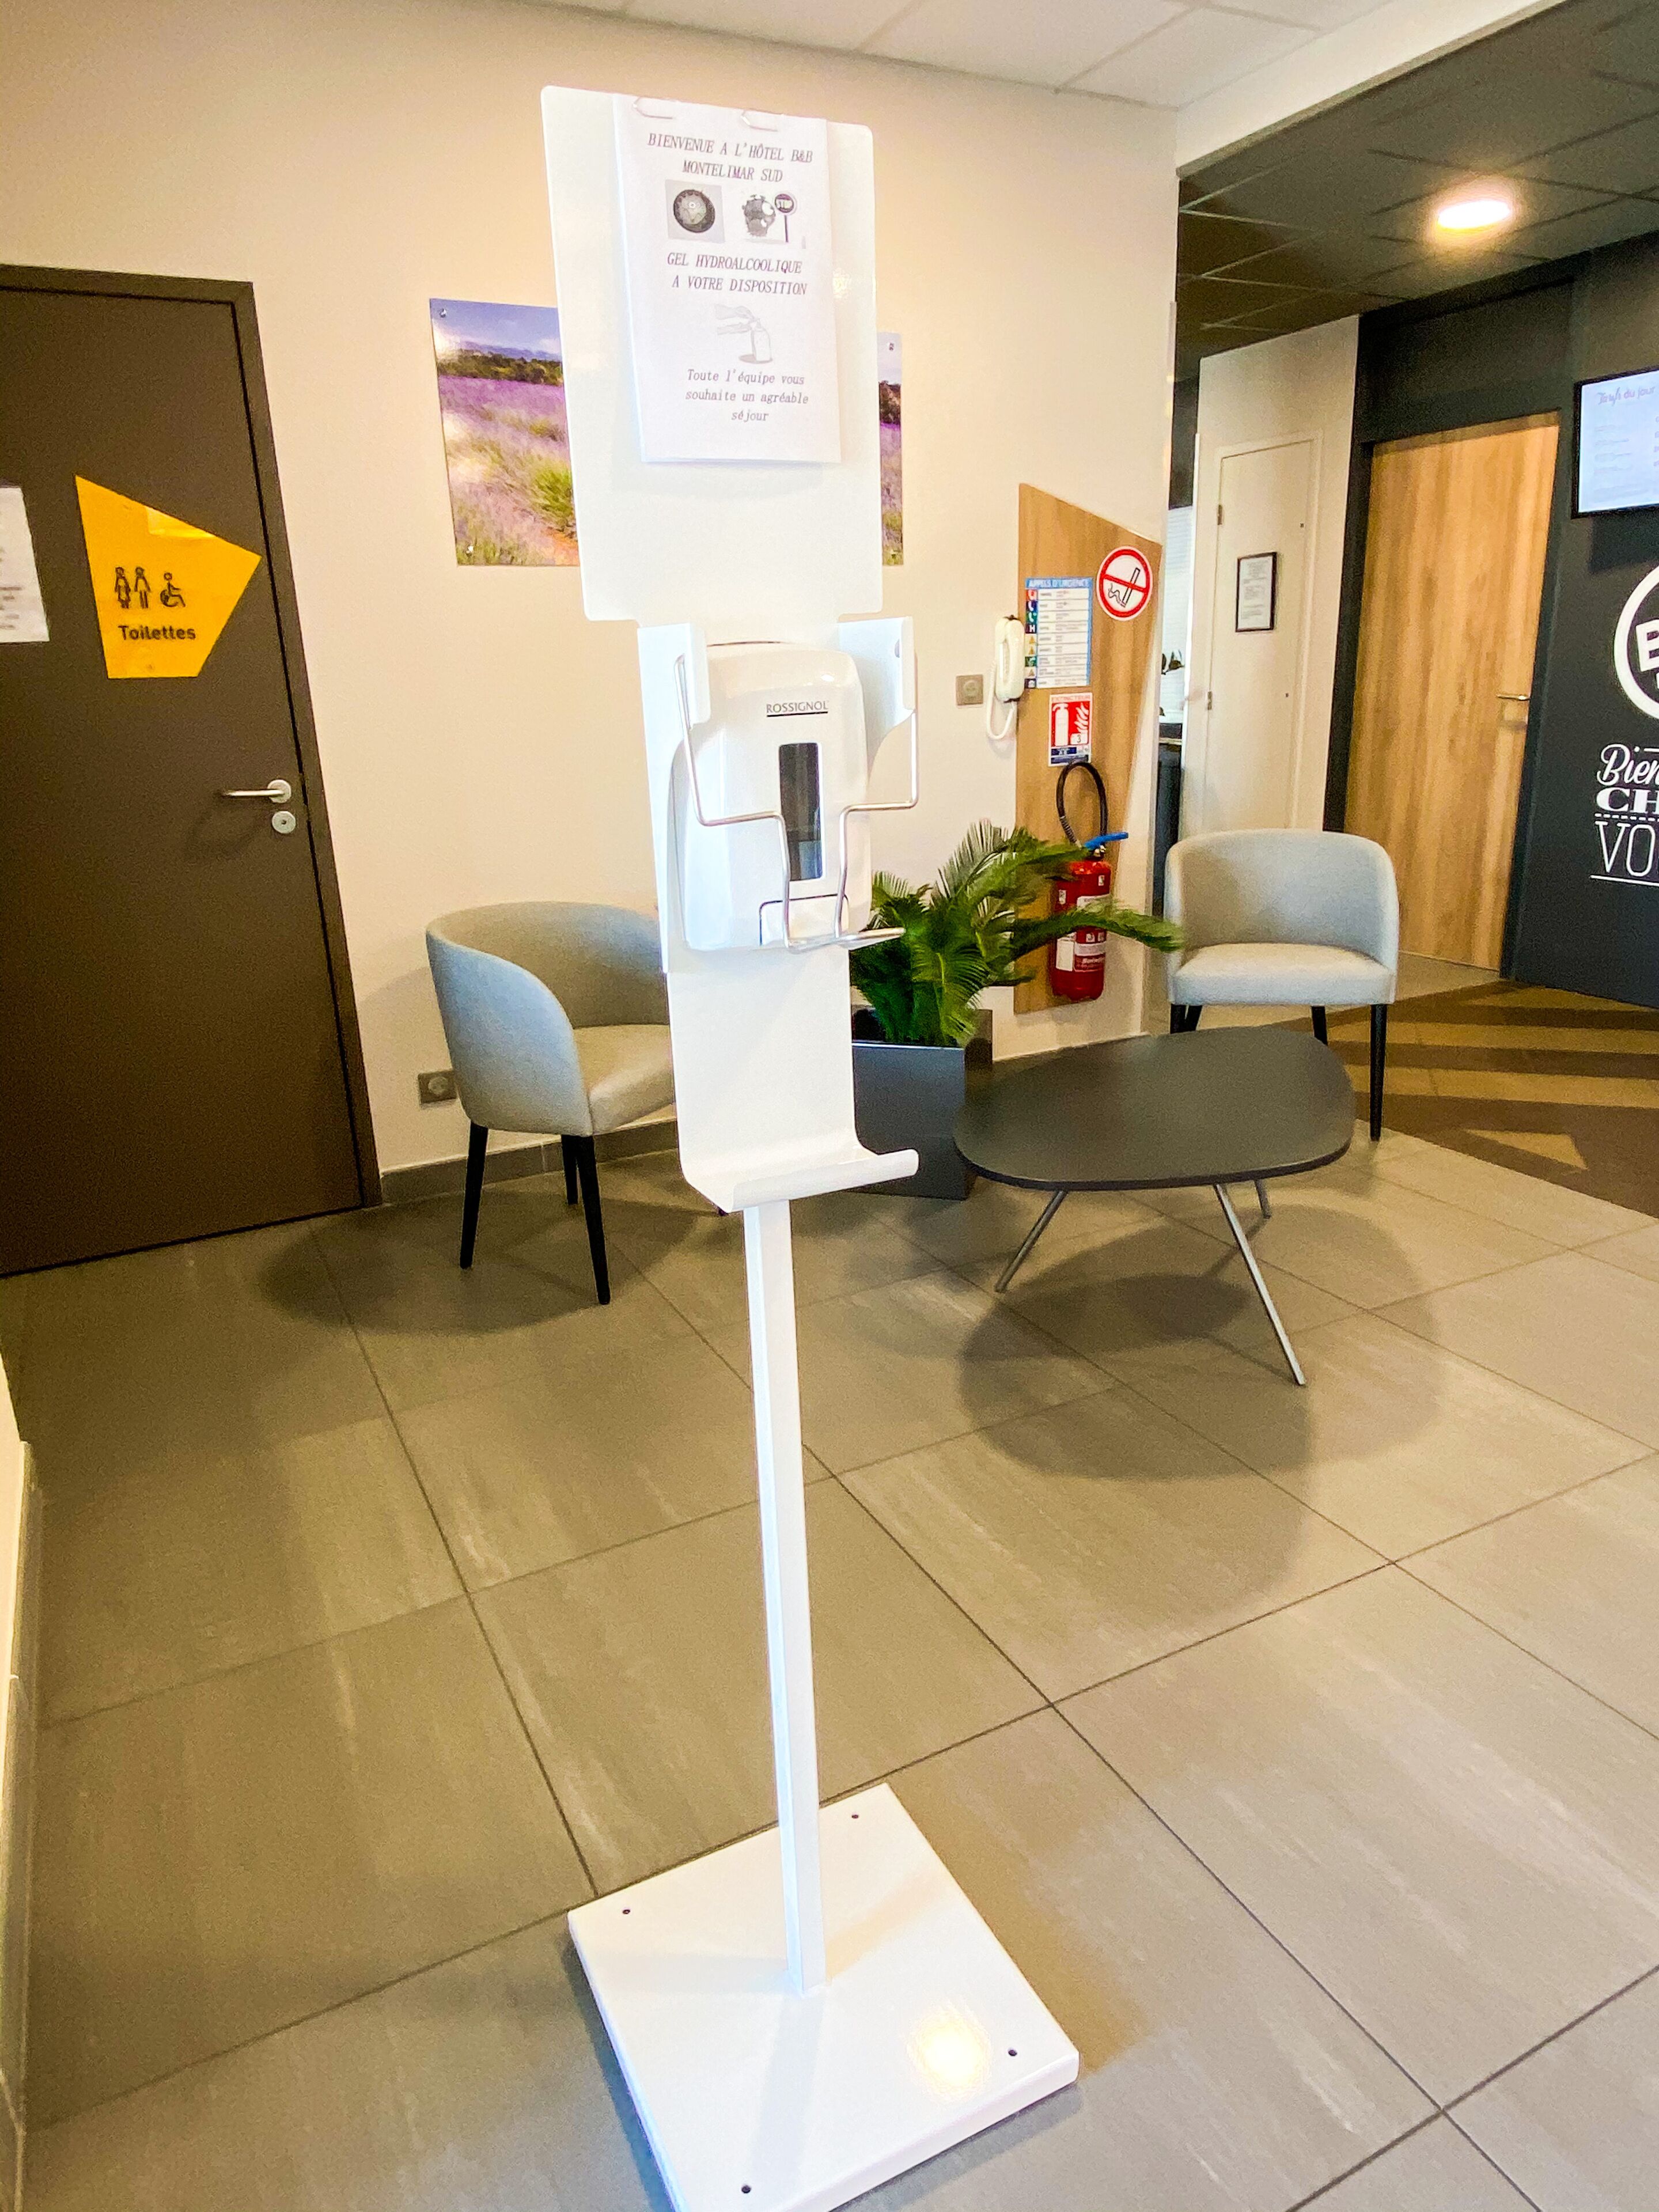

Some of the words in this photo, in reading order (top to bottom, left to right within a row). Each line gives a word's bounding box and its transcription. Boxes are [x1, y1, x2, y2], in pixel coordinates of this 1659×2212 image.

[647, 132, 715, 153] BIENVENUE
[719, 142, 728, 156] A
[791, 149, 813, 164] B&B
[683, 160, 755, 181] MONTELIMAR
[760, 168, 783, 183] SUD
[667, 252, 689, 266] GEL
[695, 254, 803, 274] HYDROALCOOLIQUE
[672, 275, 680, 288] A
[688, 275, 724, 290] VOTRE
[729, 278, 808, 295] DISPOSITION
[687, 369, 719, 381] Toute
[781, 375, 805, 385] vous
[685, 388, 737, 402] souhaite
[741, 392, 755, 402] un
[760, 391, 809, 404] agréable
[731, 409, 770, 423] séjour
[118, 625, 196, 641] Toilettes
[766, 700, 829, 713] ROSSIGNOL
